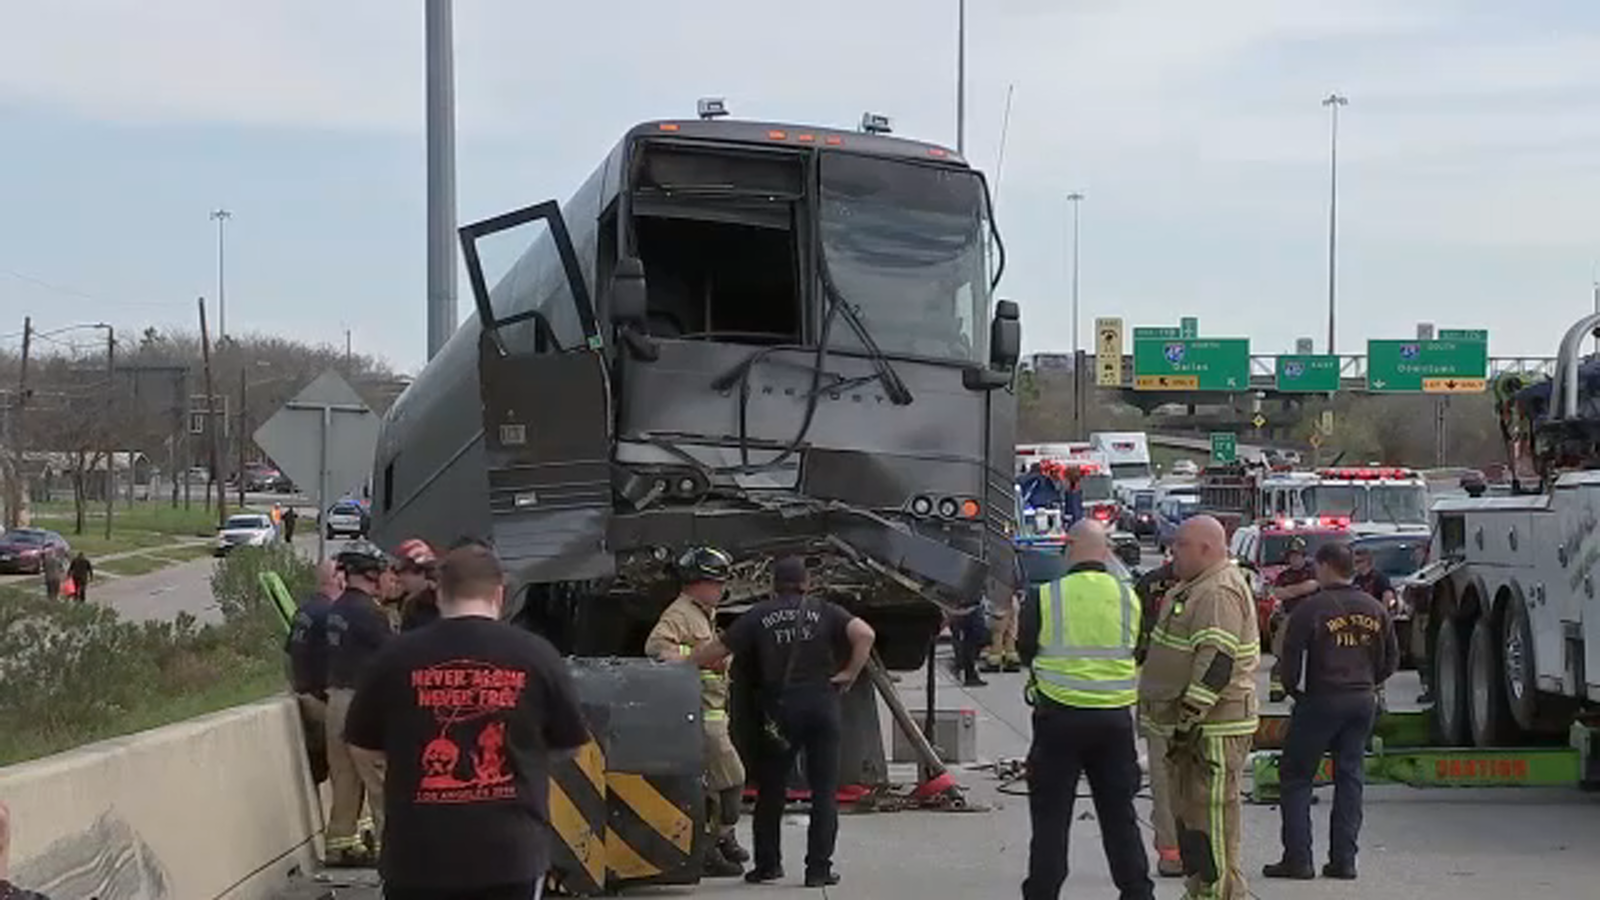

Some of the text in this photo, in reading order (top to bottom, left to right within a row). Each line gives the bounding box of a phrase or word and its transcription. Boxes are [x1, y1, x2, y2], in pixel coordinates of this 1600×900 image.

[1311, 361, 1334, 369] EAST
[1397, 363, 1456, 373] Downtown
[744, 386, 884, 404] REOST
[761, 608, 821, 629] HOUSN
[774, 626, 814, 645] FIE
[411, 668, 527, 688] NEVER ALONE
[418, 687, 516, 708] NEVER FREE
